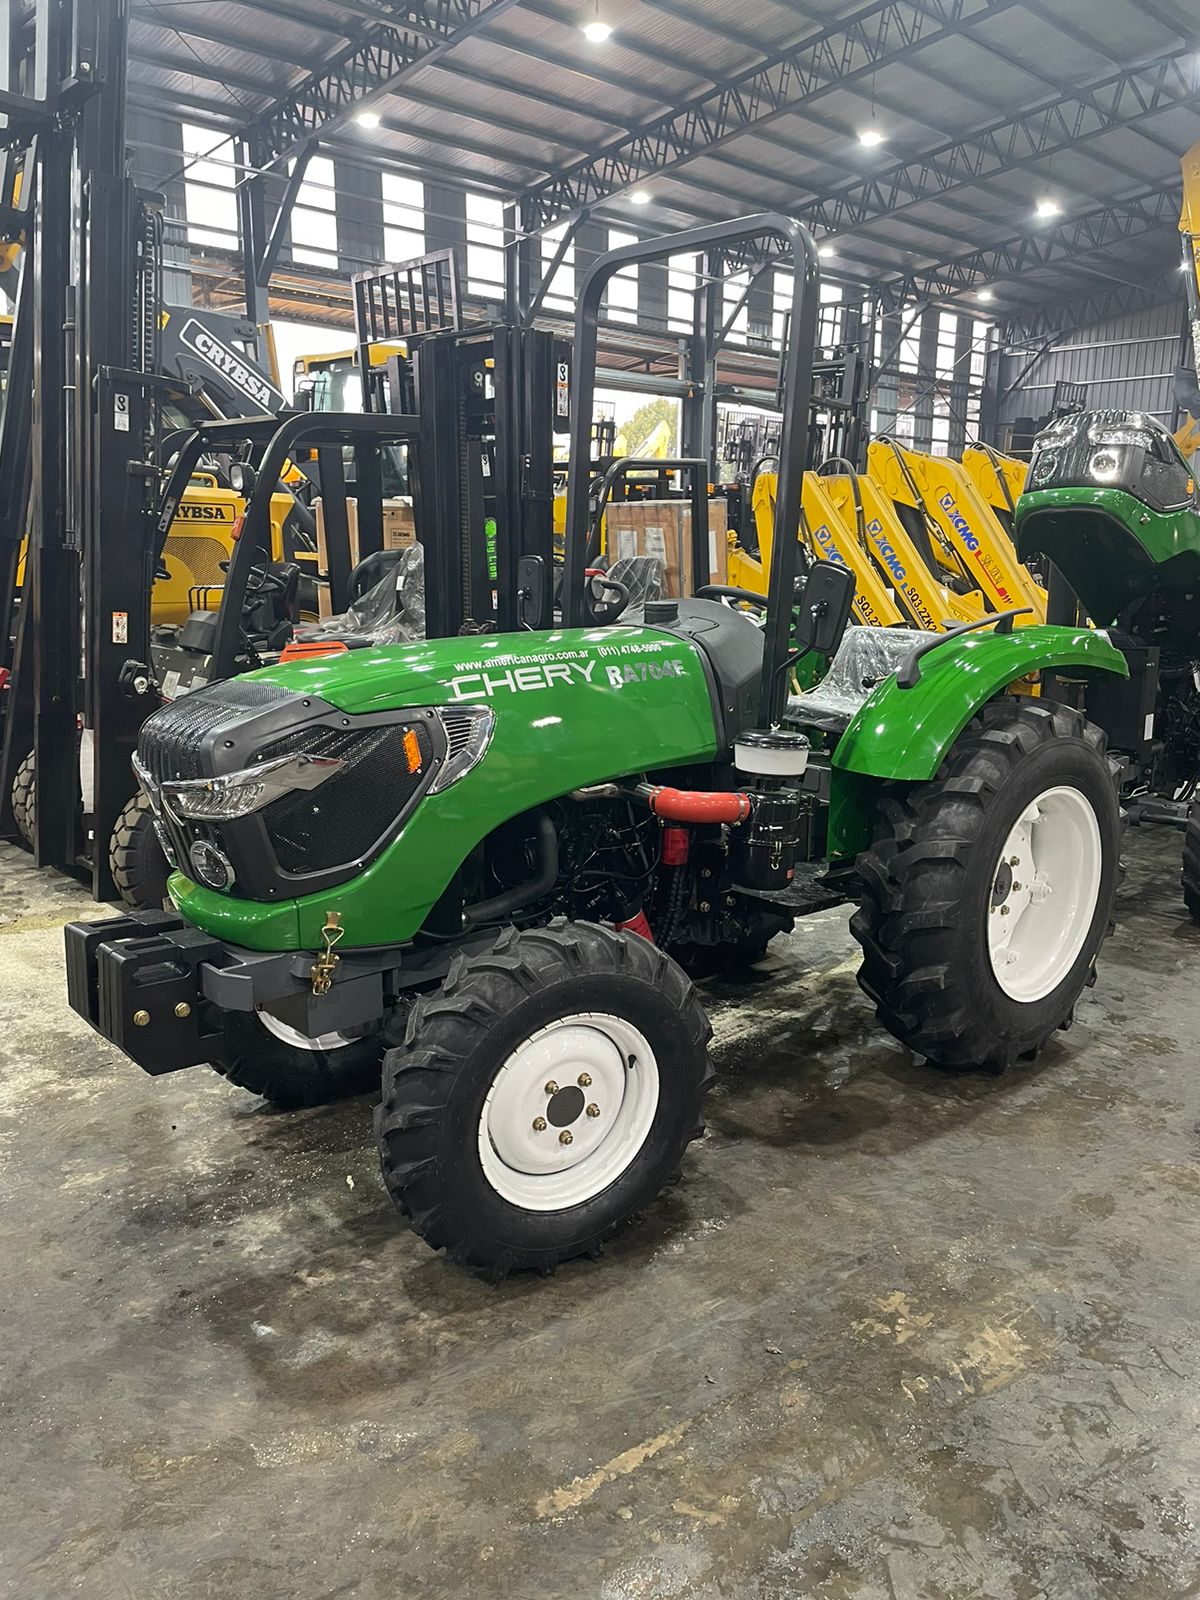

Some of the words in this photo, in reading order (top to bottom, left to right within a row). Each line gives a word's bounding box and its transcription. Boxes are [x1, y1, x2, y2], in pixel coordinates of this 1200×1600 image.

[195, 334, 271, 407] CRYBSA
[947, 506, 980, 552] XCMG
[873, 535, 907, 581] XCMG
[597, 646, 621, 658] (011)
[450, 659, 597, 700] CHERY
